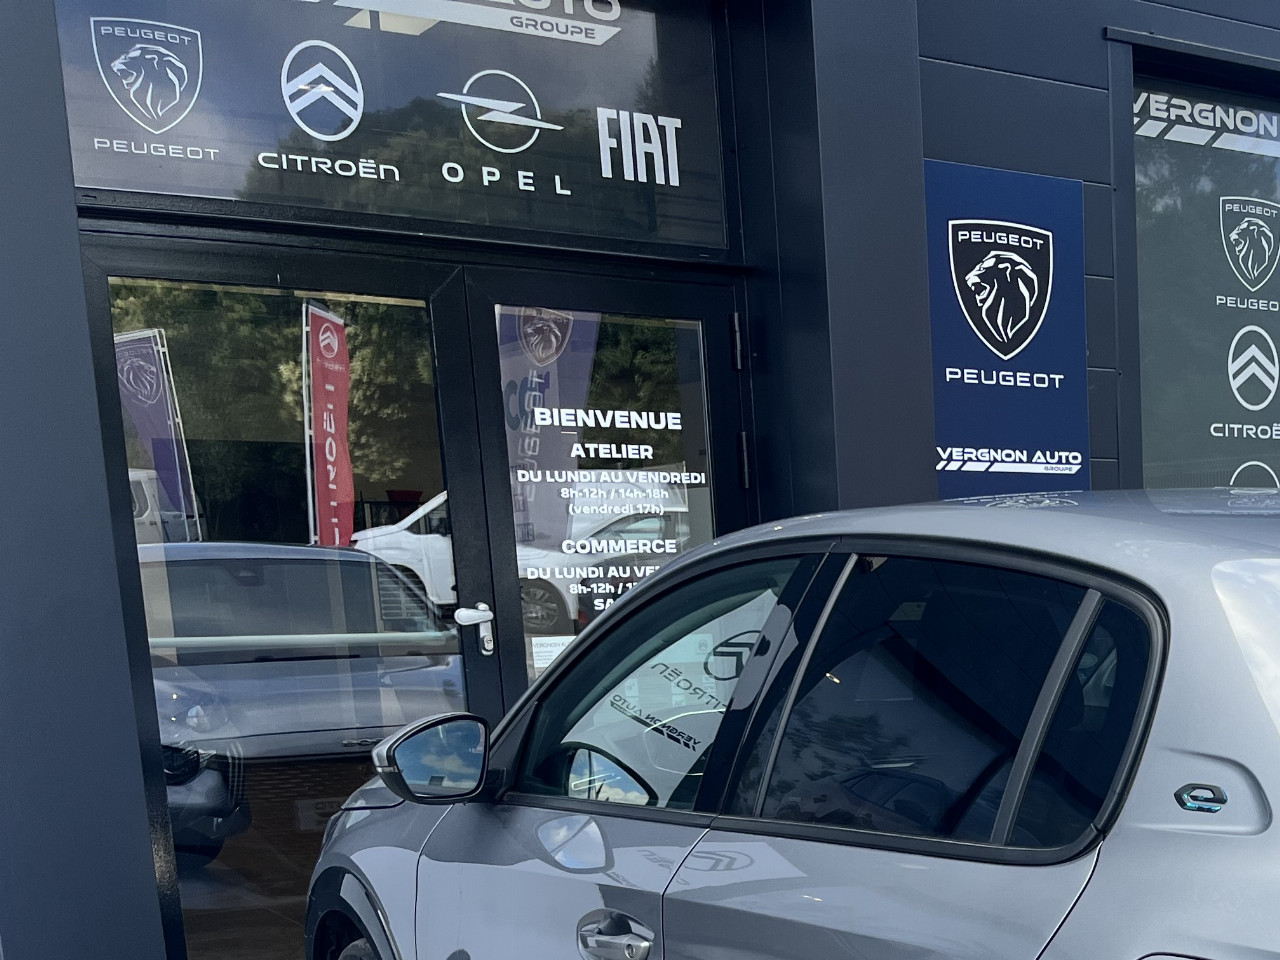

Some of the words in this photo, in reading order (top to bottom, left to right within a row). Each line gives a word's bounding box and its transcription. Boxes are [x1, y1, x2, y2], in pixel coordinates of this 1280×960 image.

[101, 26, 192, 46] PEUGEOT
[509, 16, 596, 39] GROUPE
[94, 138, 219, 161] PEUGEOT
[598, 107, 683, 187] FIAT
[257, 151, 401, 181] CITROËN
[442, 162, 571, 196] OPEL
[1225, 203, 1278, 218] PEUGEOT
[958, 231, 1044, 250] PEUGEOT
[945, 367, 1065, 389] PEUGEOT
[534, 407, 683, 431] BIENVENUE
[570, 443, 653, 460] ATELIER
[936, 446, 1028, 463] VERGNON
[1031, 450, 1082, 464] AUTO
[517, 470, 542, 483] DU
[546, 470, 596, 484] LUNDI
[600, 472, 623, 483] AU
[627, 473, 706, 485] VENDREDI
[560, 487, 607, 500] 8h-12h
[568, 504, 633, 516] (vendredi
[636, 504, 665, 516] 17h)
[561, 539, 677, 554] COMMERCE
[527, 567, 550, 580] DU
[554, 567, 604, 579] LUNDI
[607, 566, 631, 578] AU
[569, 583, 615, 595] 8h-12h
